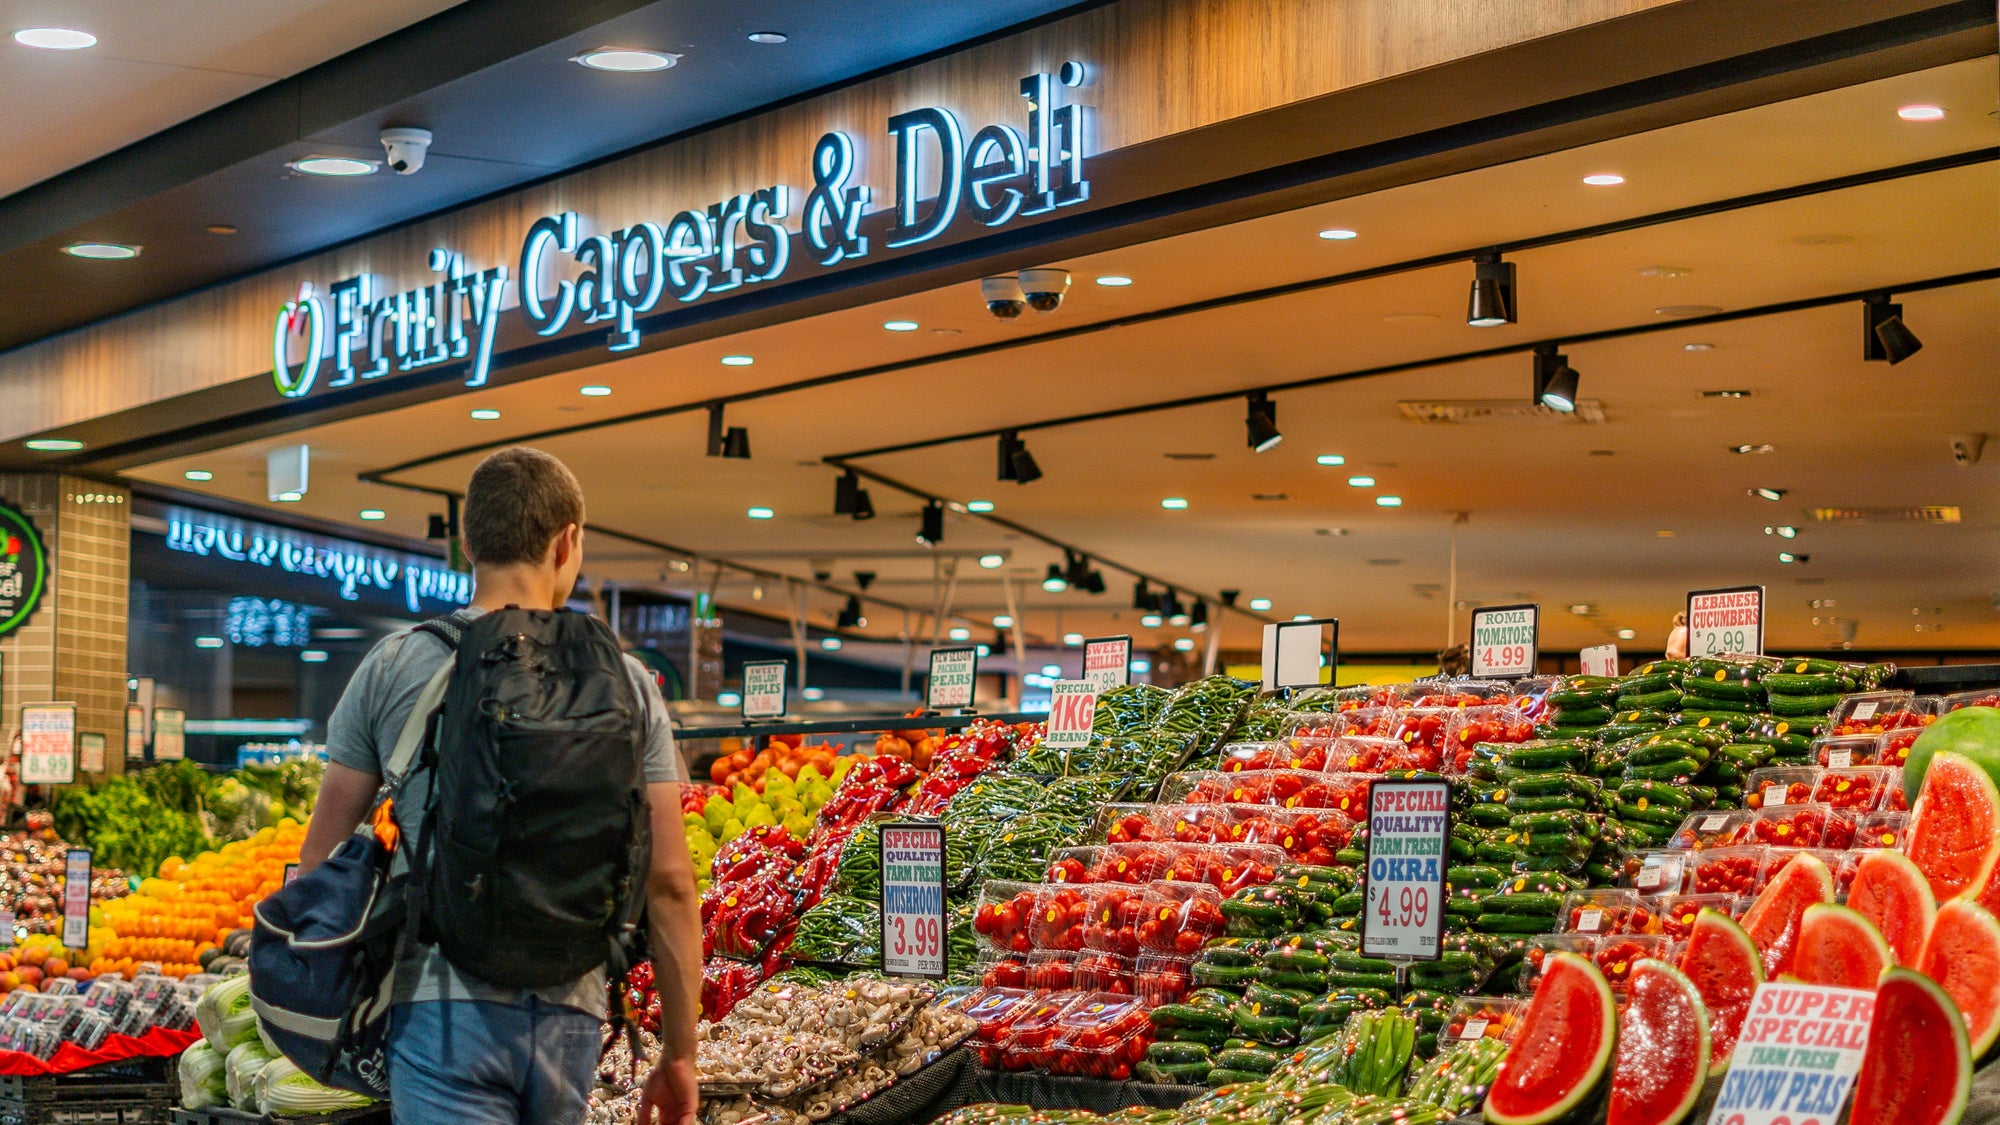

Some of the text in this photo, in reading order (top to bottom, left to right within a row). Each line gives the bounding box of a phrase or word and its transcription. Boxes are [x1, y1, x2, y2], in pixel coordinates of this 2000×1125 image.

[328, 60, 1091, 388] Fruity Capers & Deli
[1694, 592, 1759, 610] LEBANESE
[1485, 611, 1526, 625] ROMA
[1692, 608, 1759, 629] CUCUMBERS
[1476, 625, 1534, 647] TOMATOES
[1086, 641, 1126, 656] SWEET
[1085, 654, 1125, 671] CHILLIES
[747, 683, 781, 695] APPLES
[930, 674, 971, 687] PEARS
[1055, 683, 1095, 694] SPECIAL
[1053, 694, 1094, 732] 1KG
[1049, 732, 1089, 743] BEANS
[29, 756, 68, 774] 8.99
[1374, 790, 1446, 812] SPECIAL
[1372, 815, 1444, 837] QUALITY
[885, 831, 941, 849] SPECIAL
[1372, 837, 1441, 855] FARM FRESH
[885, 850, 941, 863] QUALITY
[885, 864, 941, 882] FARM FRESH
[1371, 857, 1439, 882] OKRA
[885, 884, 941, 915] MUSHROOM
[917, 960, 928, 970] PER
[1755, 988, 1877, 1022] SUPER
[1742, 1017, 1865, 1050] SPECIAL
[1748, 1046, 1841, 1070] FARM FRESH
[1718, 1068, 1849, 1115] SNOW PEAS
